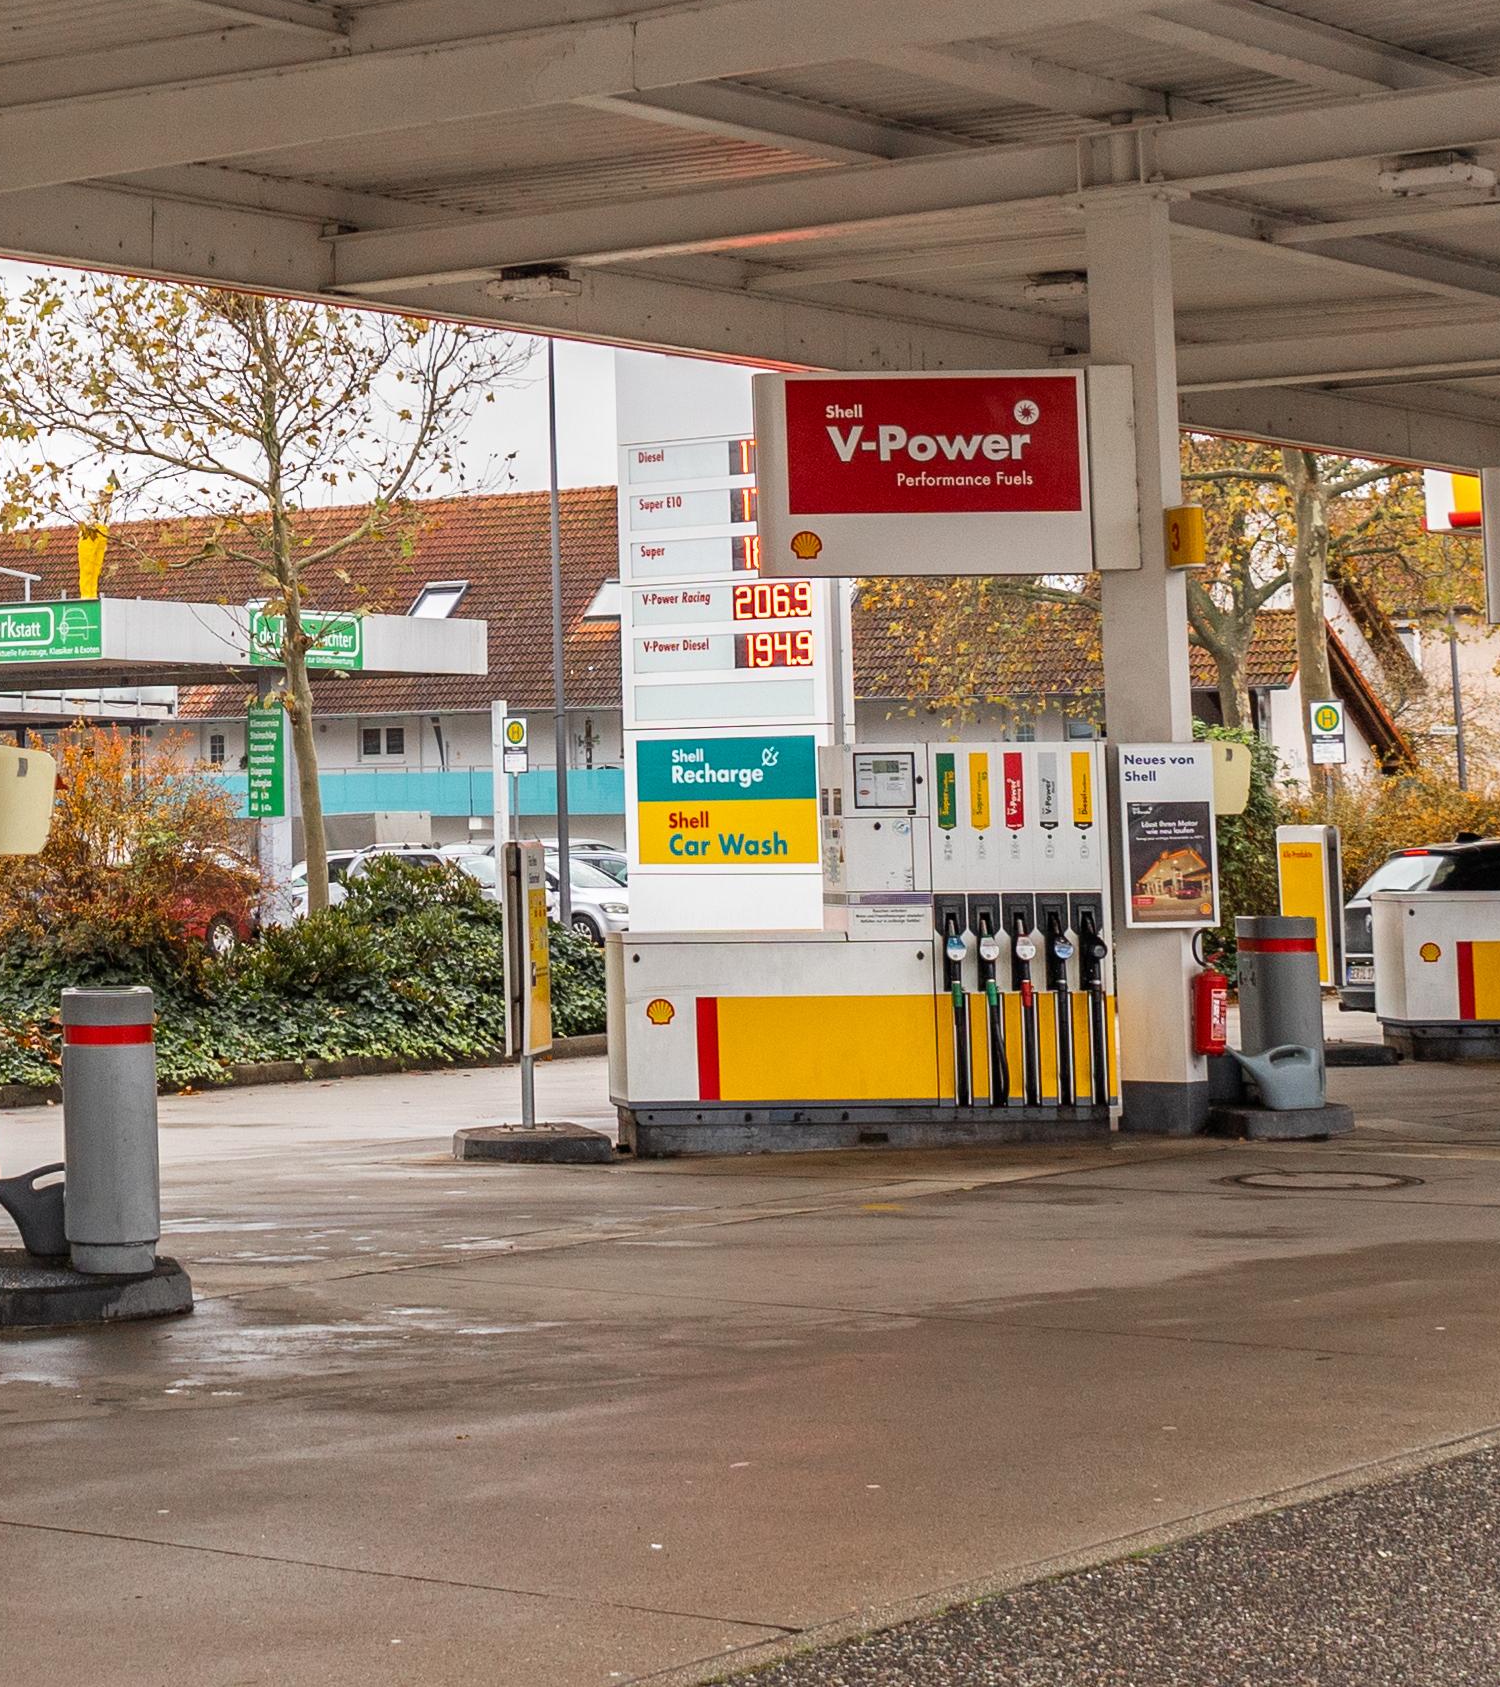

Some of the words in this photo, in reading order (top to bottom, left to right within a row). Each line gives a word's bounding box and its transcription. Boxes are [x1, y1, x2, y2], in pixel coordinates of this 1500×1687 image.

[825, 404, 862, 418] Shell
[826, 425, 1030, 462] V-Power
[638, 450, 664, 464] Diesel
[897, 472, 991, 487] Performance
[996, 470, 1033, 485] Fuels
[639, 499, 664, 512] Super
[666, 496, 682, 508] E10
[1171, 522, 1180, 552] 3
[640, 545, 666, 558] Super
[642, 593, 679, 605] V-Power
[682, 592, 711, 606] Racing
[735, 582, 812, 619] 206.9
[643, 641, 680, 652] V-Power
[683, 639, 710, 651] Diesel
[746, 631, 814, 668] 194.9
[671, 748, 704, 763] Shell
[1124, 754, 1166, 766] Neues
[1169, 756, 1195, 766] von
[671, 763, 764, 788] Recharge
[1125, 770, 1157, 782] Shell
[668, 811, 709, 829] Shell
[669, 833, 711, 856] Car
[718, 831, 788, 856] Wash
